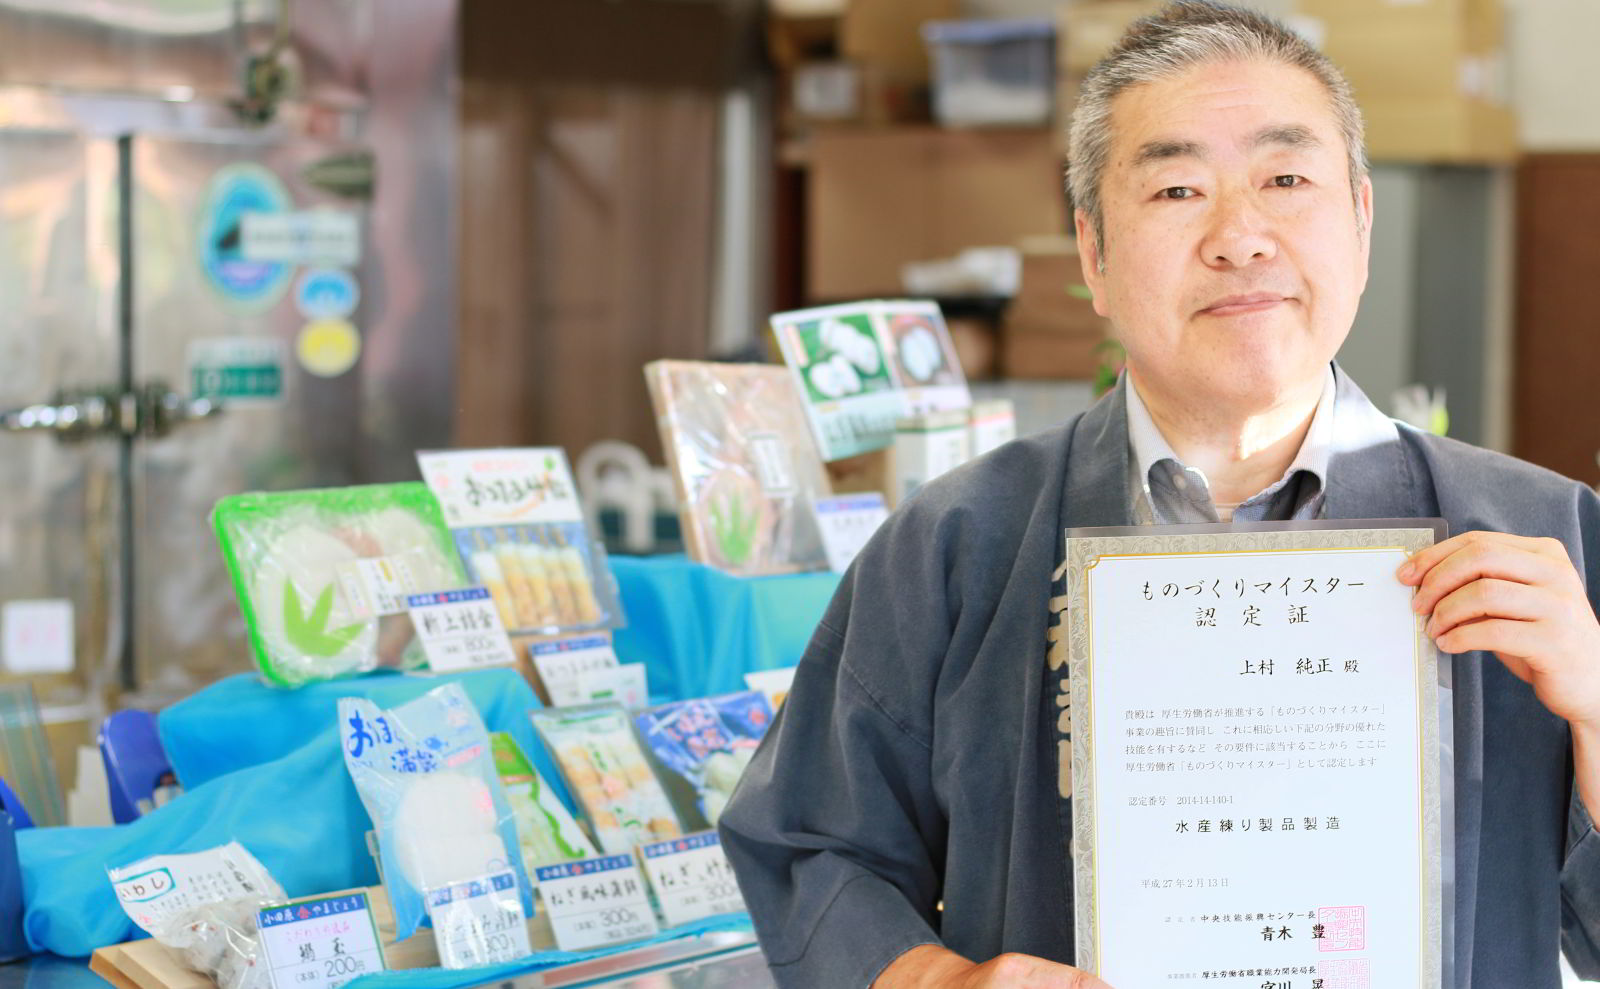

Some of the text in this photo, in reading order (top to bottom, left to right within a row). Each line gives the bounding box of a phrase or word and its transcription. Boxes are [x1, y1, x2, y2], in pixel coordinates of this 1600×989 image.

[1142, 576, 1366, 602] ものづくりマイスター
[1195, 605, 1310, 628] 認定証
[1128, 795, 1234, 807] 認定番号 2014-14-140-1
[1175, 816, 1341, 833] 水産練り製品製造
[264, 896, 358, 925] 小田原 やまじょう
[1260, 925, 1293, 941] 青木
[325, 956, 366, 978] 200円
